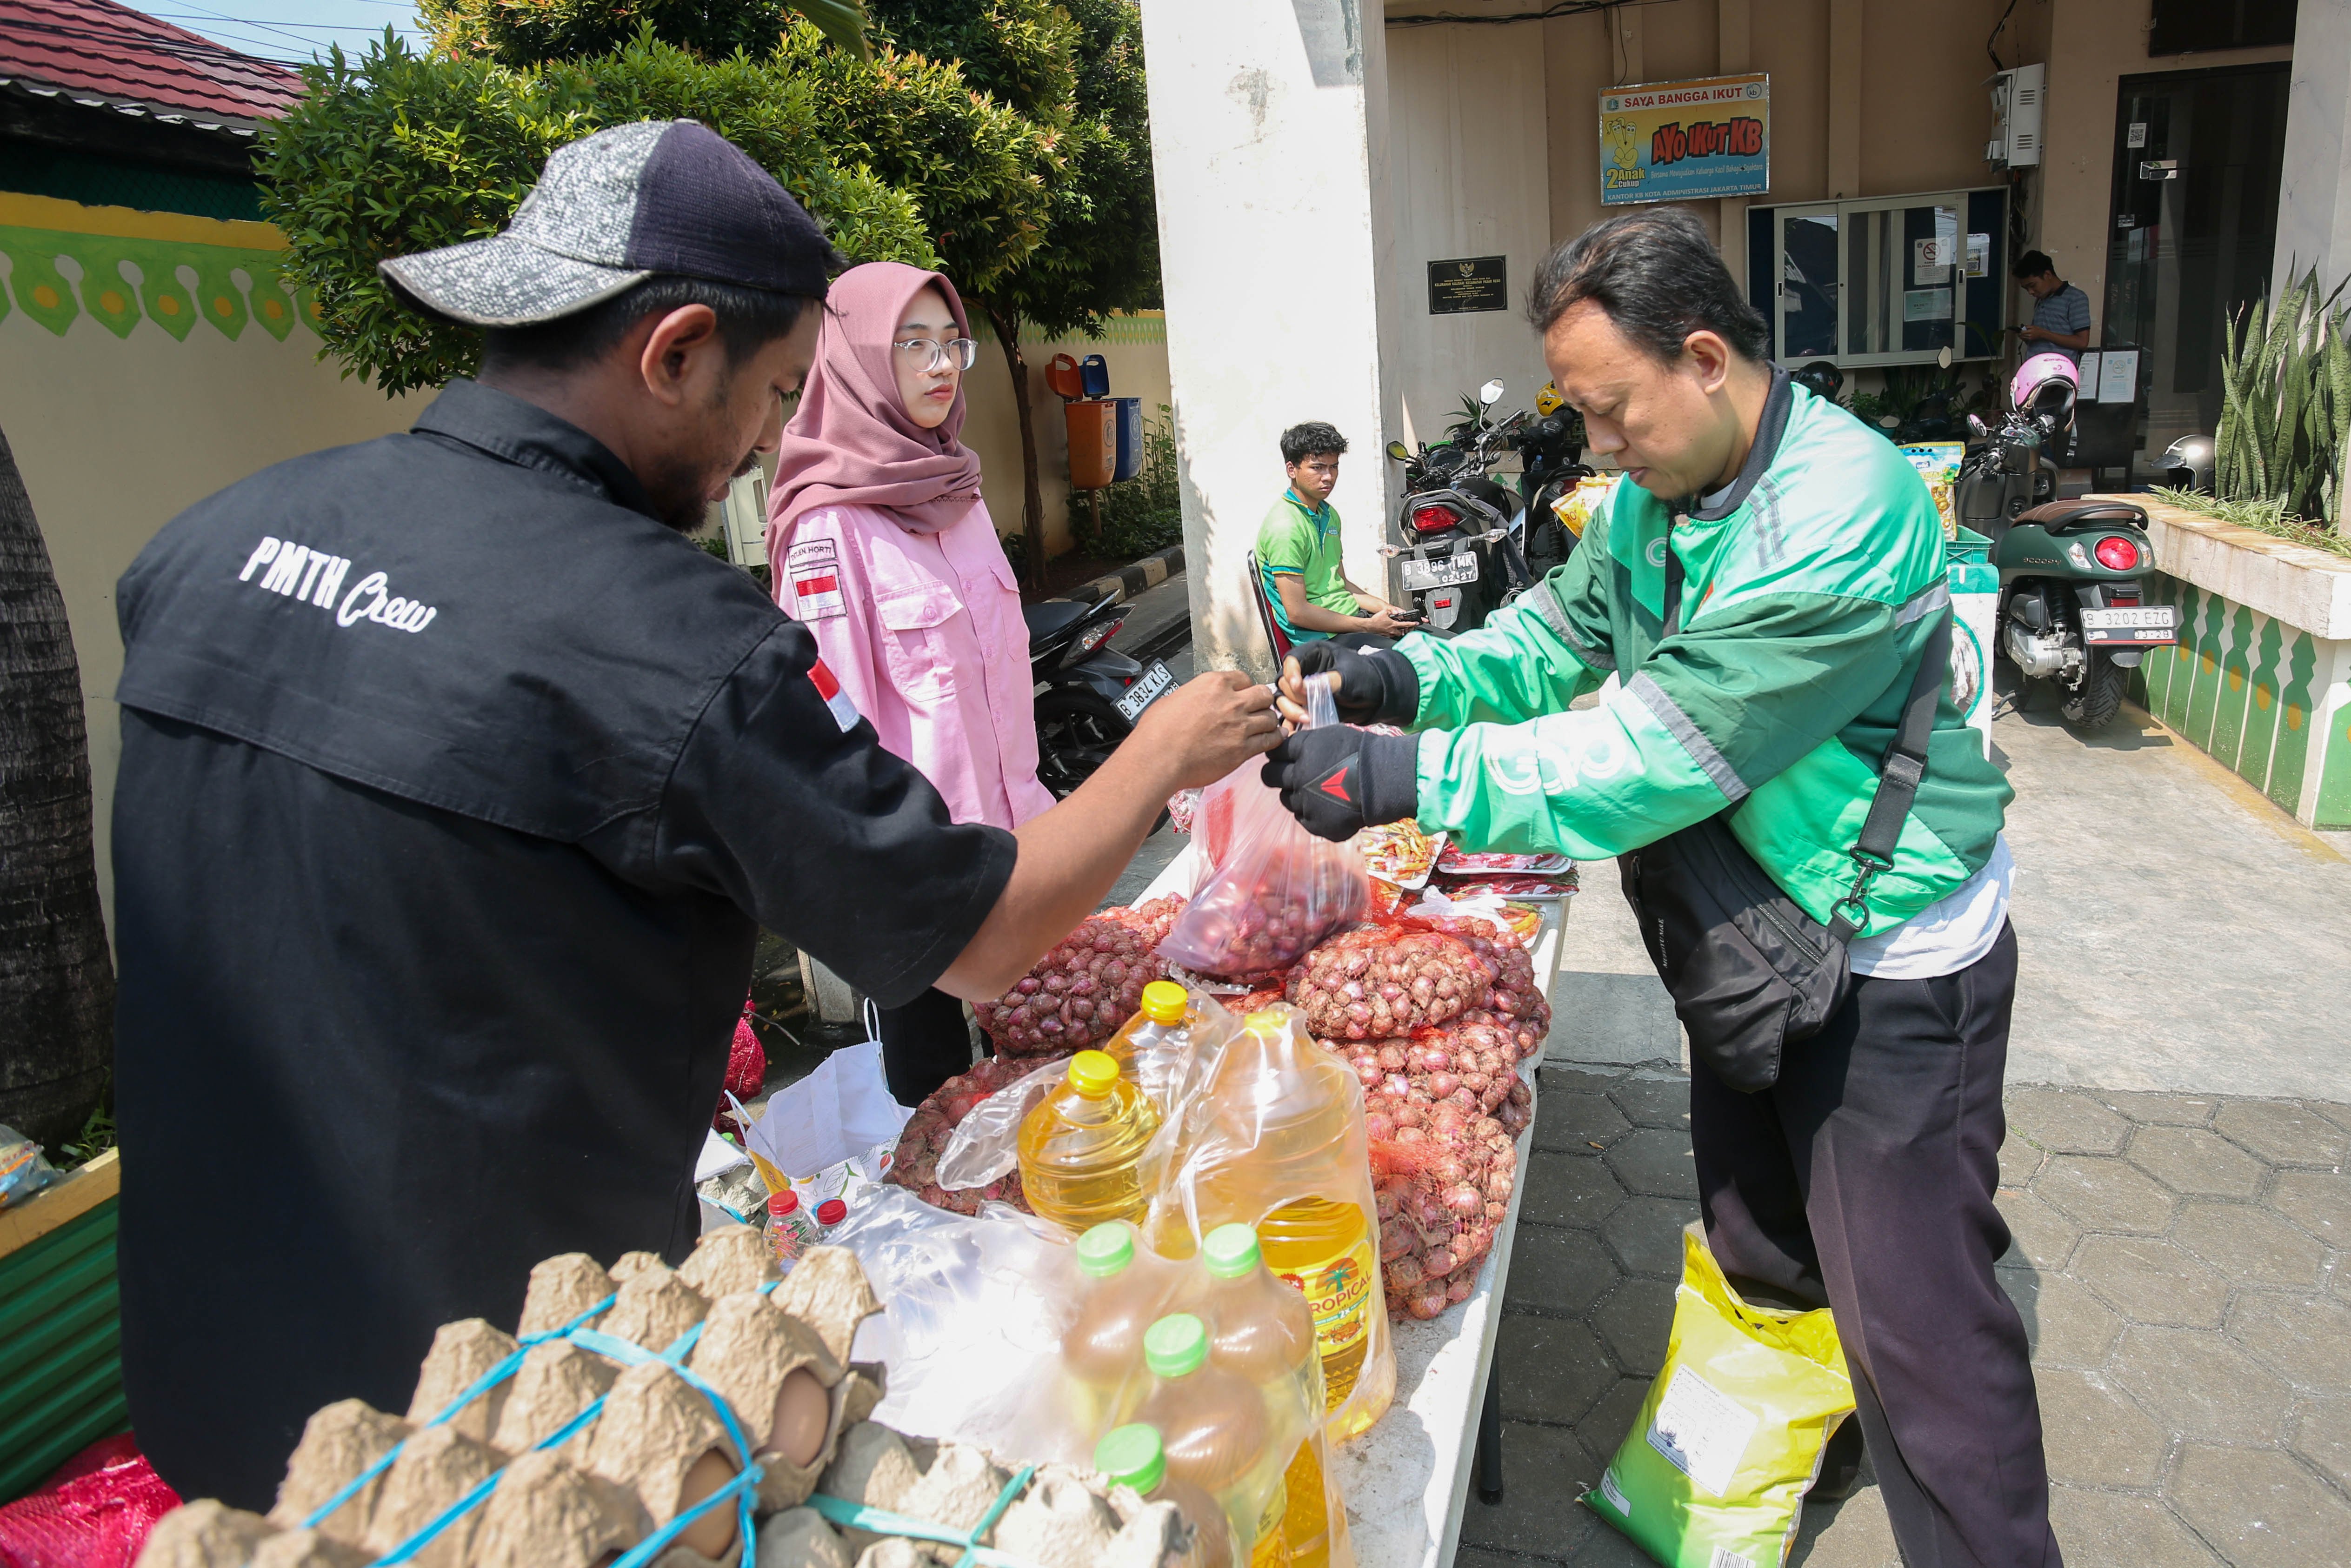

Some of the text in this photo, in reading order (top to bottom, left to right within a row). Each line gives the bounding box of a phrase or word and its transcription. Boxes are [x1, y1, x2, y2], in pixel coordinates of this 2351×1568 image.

[1625, 87, 1742, 107] SAYA BANGGA IKUT
[1652, 118, 1763, 164] AYO IKUT KB
[1606, 167, 1645, 189] 2 Anak
[1663, 187, 1709, 196] ADMINISTRASI
[1405, 554, 1474, 576] B 3896 TMK
[239, 536, 437, 633] PMTH Crew
[2087, 612, 2169, 625] B 3202 EZG
[1119, 667, 1169, 716] B 3834 KIS
[1309, 1270, 1372, 1315] ROPICAL
